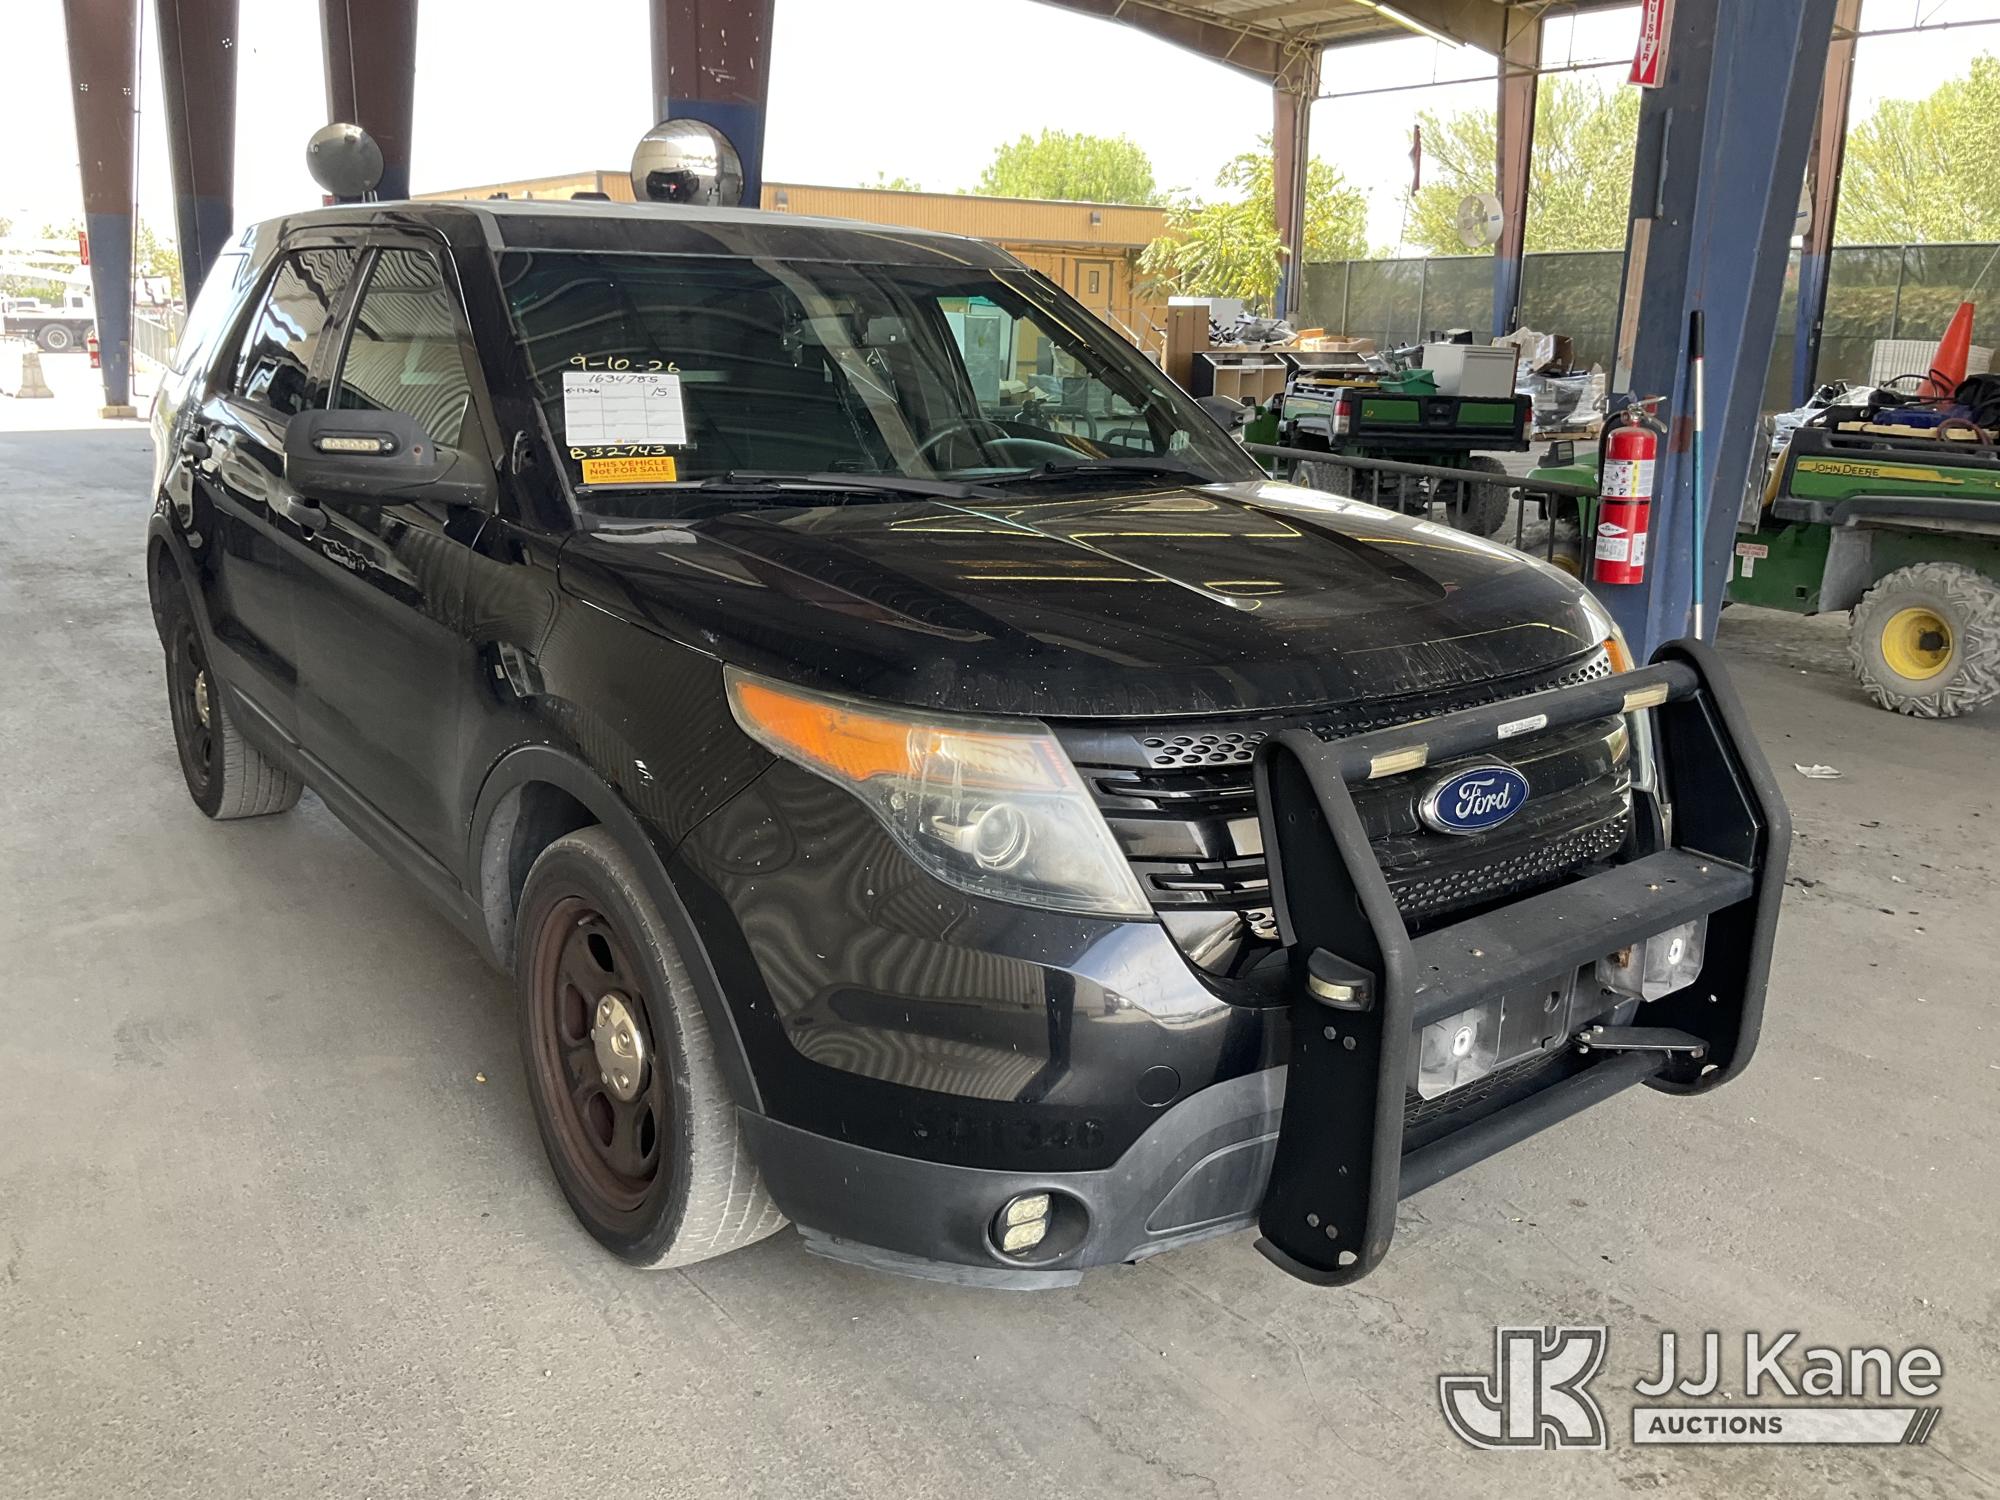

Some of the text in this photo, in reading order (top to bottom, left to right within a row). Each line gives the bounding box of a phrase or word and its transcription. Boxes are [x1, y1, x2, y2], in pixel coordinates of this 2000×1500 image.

[1642, 0, 1657, 61] UISHER
[589, 374, 658, 385] 1634785
[592, 459, 668, 469] THIS VEHICLE
[640, 465, 669, 473] SALE
[1811, 462, 1880, 476] JOHN DEERE
[1455, 778, 1511, 819] Ford
